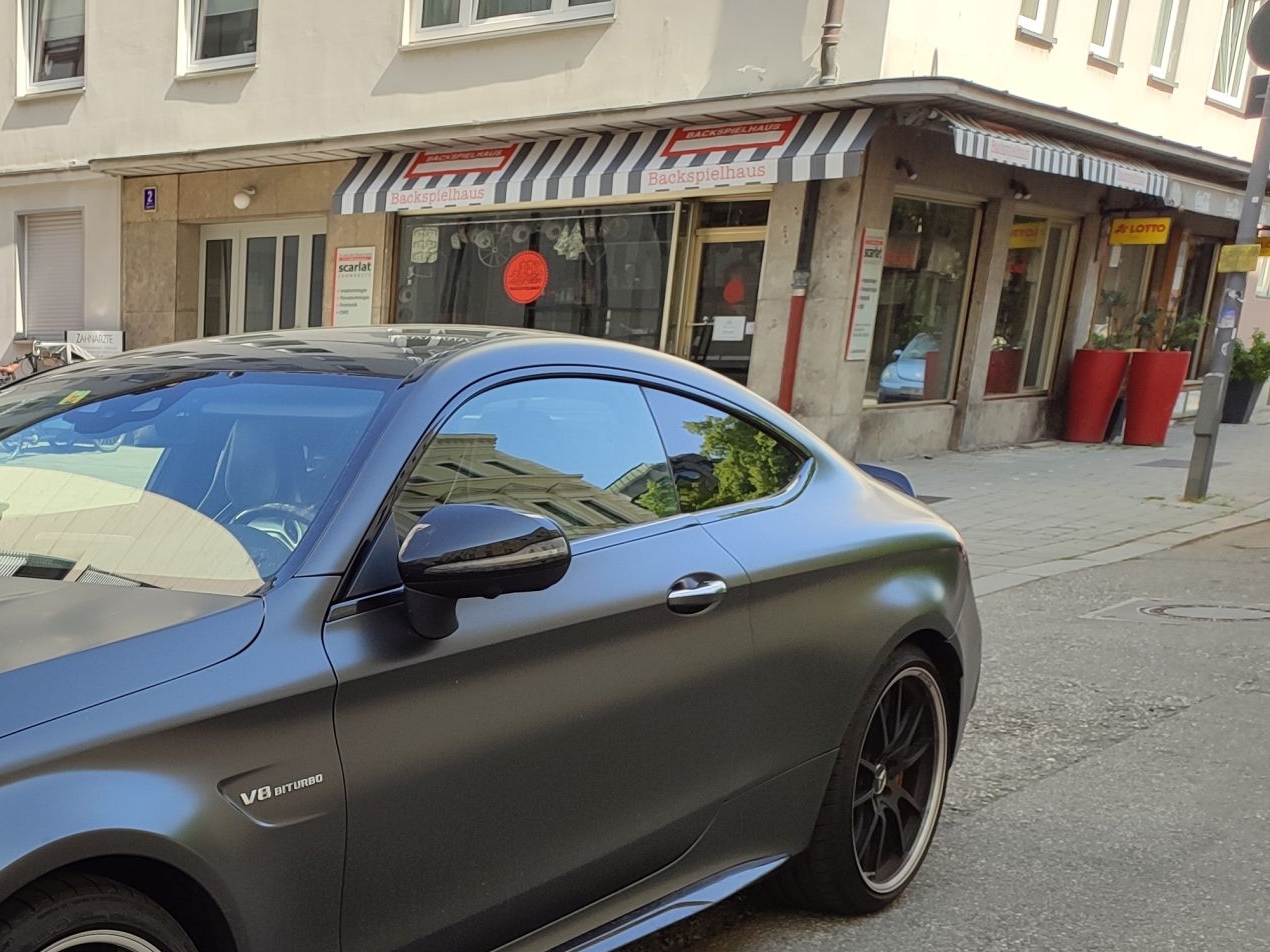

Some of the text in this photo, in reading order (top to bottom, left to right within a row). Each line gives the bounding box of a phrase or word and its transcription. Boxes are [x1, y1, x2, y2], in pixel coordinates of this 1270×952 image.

[686, 123, 782, 139] BACKSPIELHAUS
[426, 150, 502, 162] BACKSPIELHAUS
[648, 165, 766, 186] Backspielhaus
[147, 190, 153, 203] 2
[390, 187, 485, 205] Backspielhaus
[1129, 223, 1166, 234] LOTTO
[338, 261, 372, 273] scarlat
[240, 773, 324, 806] V8 BITURBO
